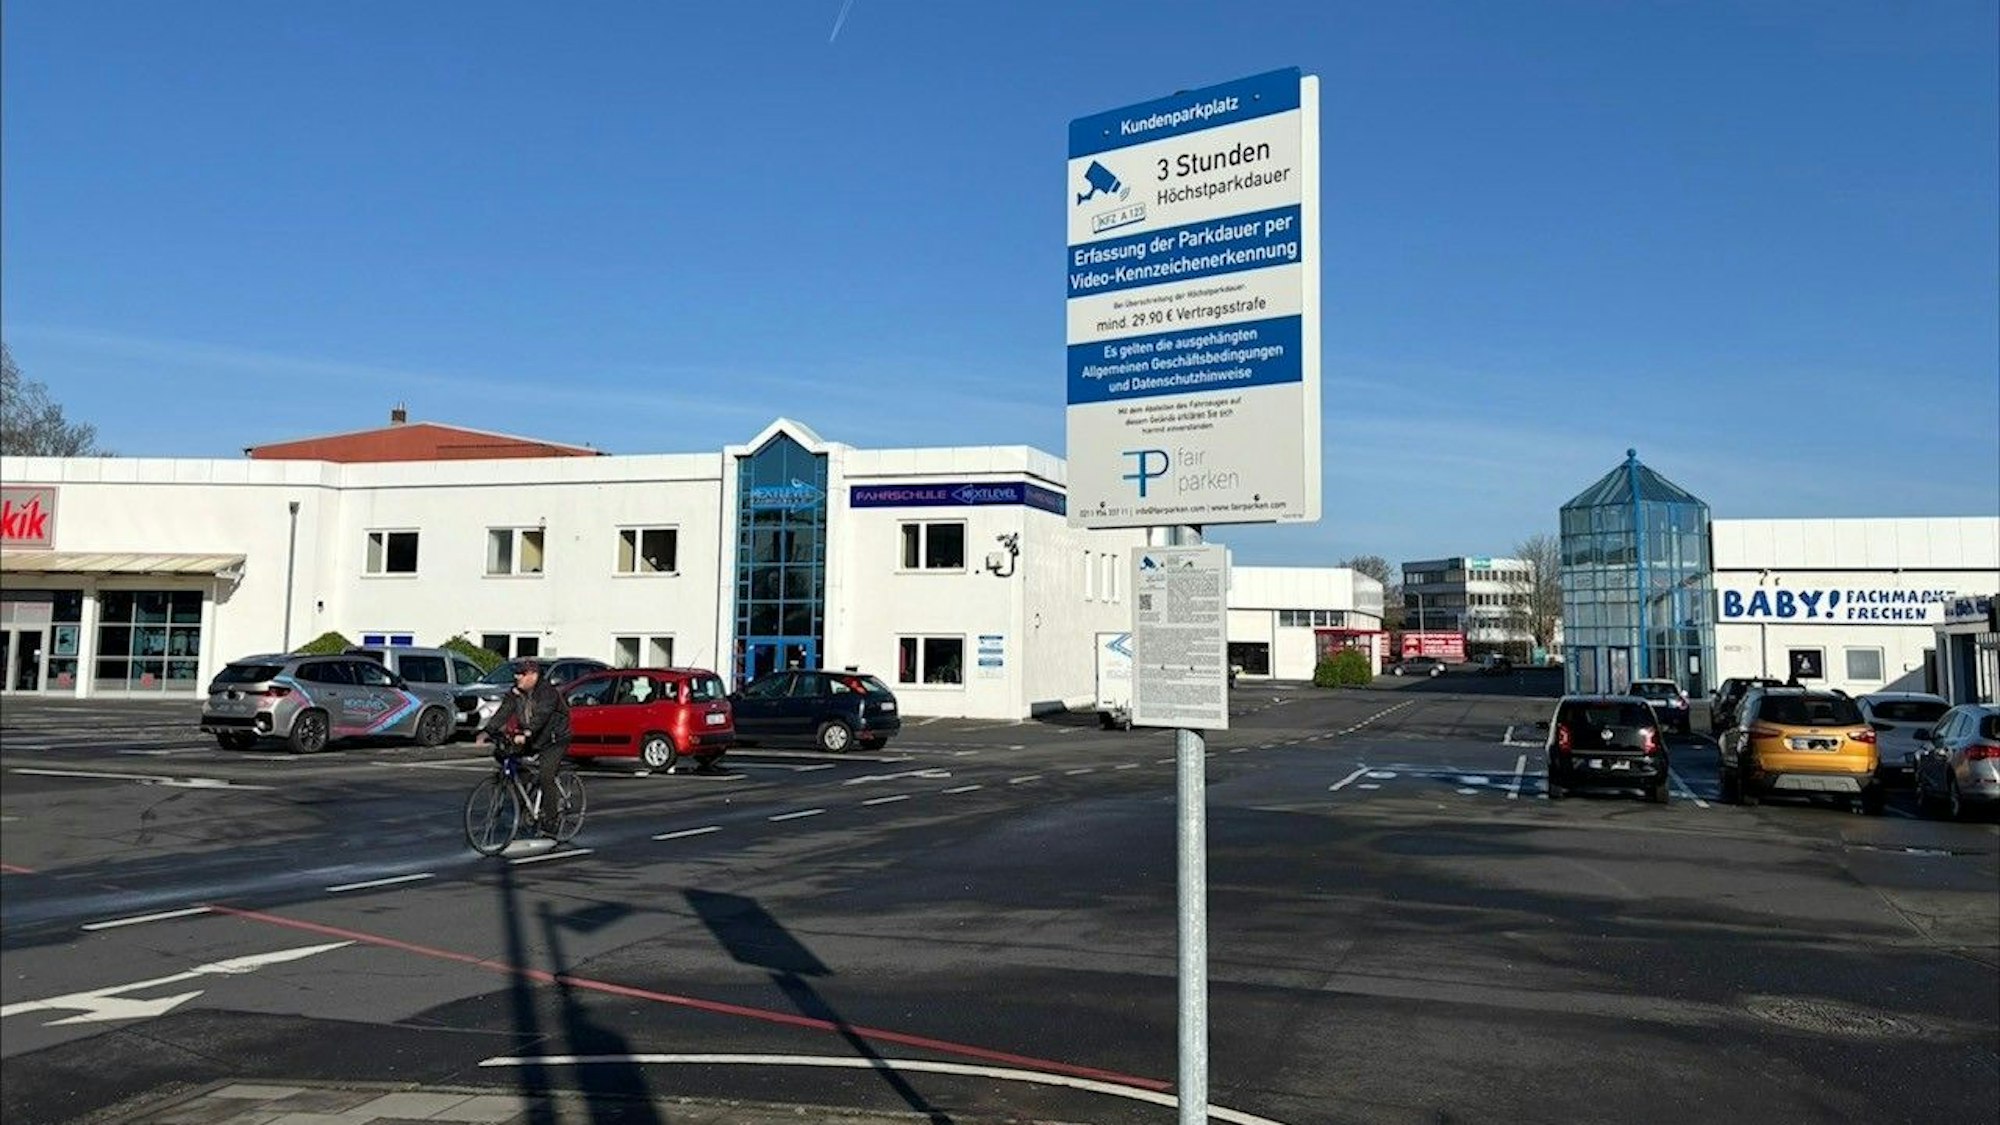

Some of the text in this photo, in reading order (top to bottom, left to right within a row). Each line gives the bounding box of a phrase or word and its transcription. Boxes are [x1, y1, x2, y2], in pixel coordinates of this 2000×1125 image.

[1121, 96, 1239, 135] Kundenparkplatz
[1157, 142, 1270, 181] 3 Stunden
[1157, 168, 1290, 205] Höchstparkdauer
[1074, 216, 1293, 267] Erfassung der Parkdauer per
[1070, 240, 1298, 289] Video-Kennzeichenerkennung
[1096, 296, 1267, 332] mind. 29.90 € Vertragsstrafe
[1104, 329, 1257, 358] Es gelten die ausgehängten
[1082, 344, 1284, 379] Allgemeinen Geschäftsbedingungen
[1109, 367, 1252, 393] und Datenschutzhinweise
[1178, 447, 1206, 467] fair
[855, 489, 947, 501] FAHRSCHULE
[961, 487, 1018, 500] NEXTLEVEL
[1178, 469, 1240, 495] parken
[1724, 589, 1841, 619] BABY!
[1847, 607, 1927, 620] FRECHEN
